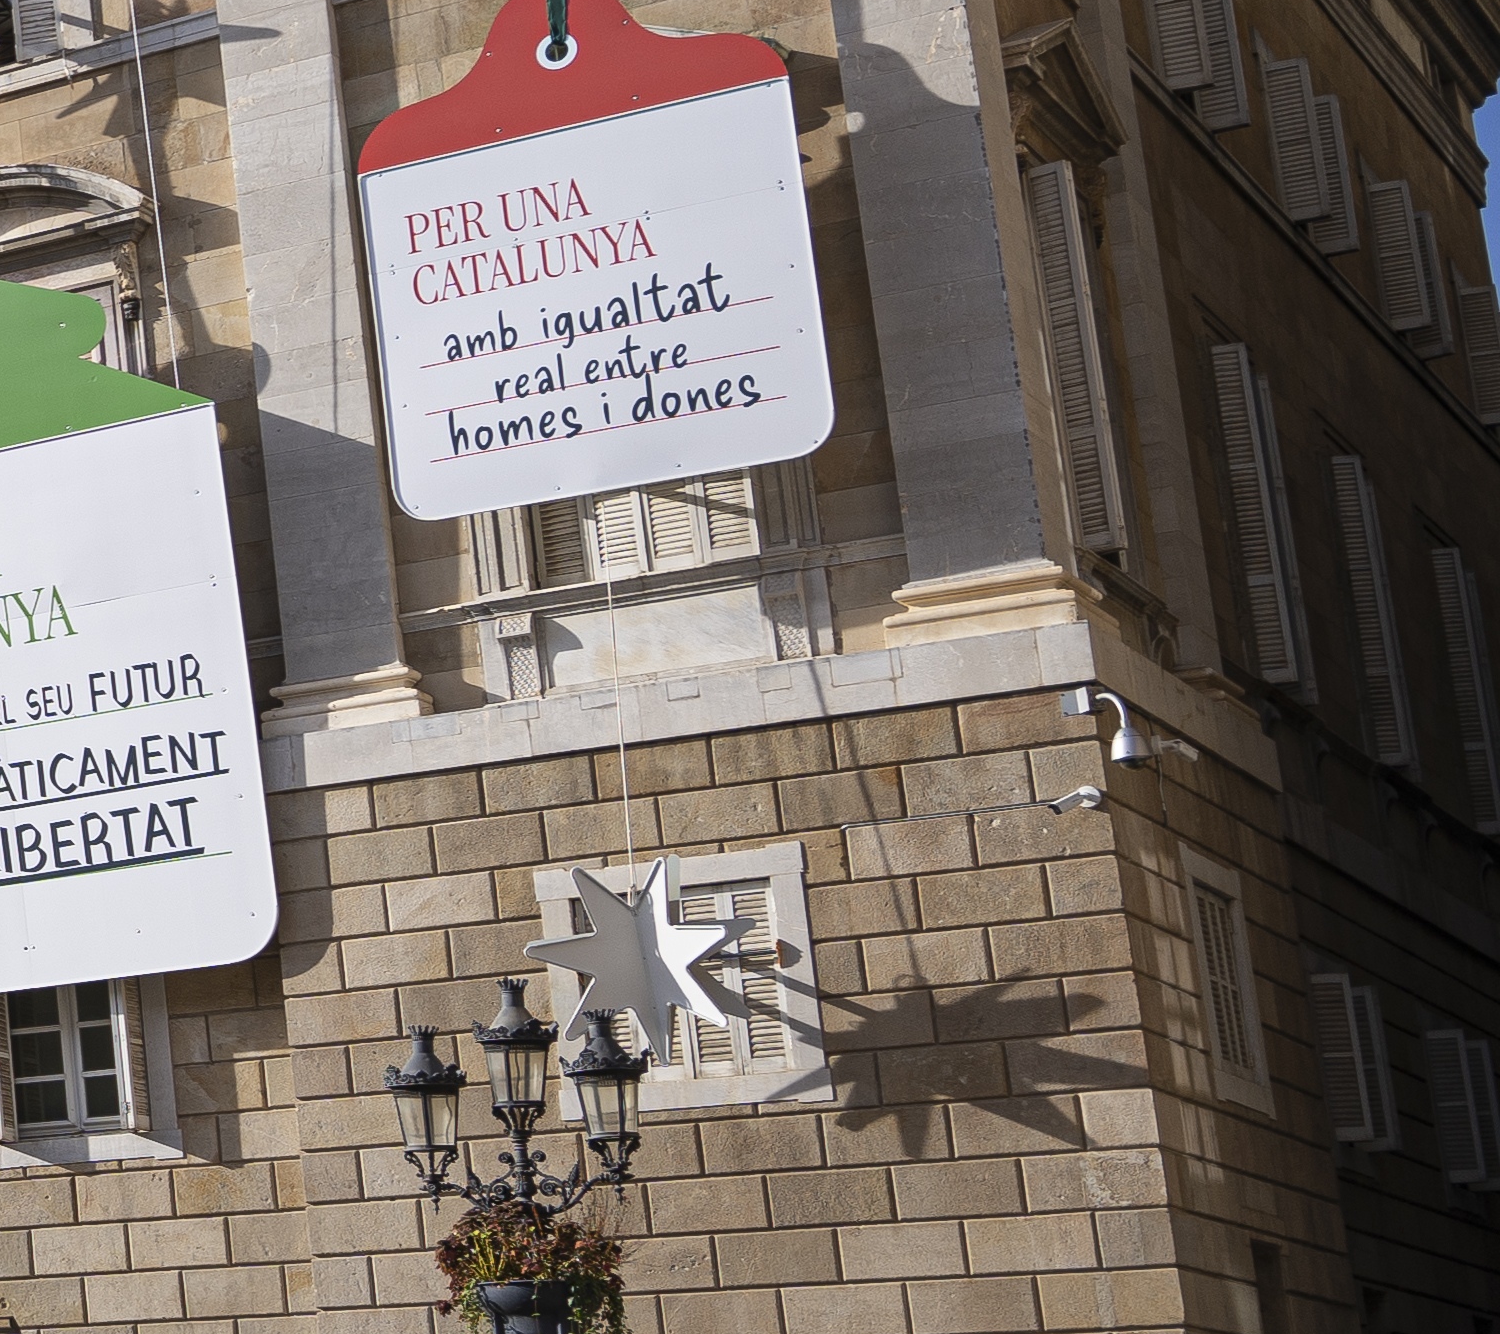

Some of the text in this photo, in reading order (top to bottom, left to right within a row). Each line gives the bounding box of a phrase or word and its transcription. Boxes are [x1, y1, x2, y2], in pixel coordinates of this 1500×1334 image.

[404, 178, 592, 255] PER UNA
[412, 218, 657, 306] CATALUNYA
[443, 262, 731, 362] amb igualtat
[494, 335, 689, 404] real entre
[448, 373, 762, 456] homes i dones
[25, 683, 74, 720] SEU
[88, 653, 206, 713] FUTUR
